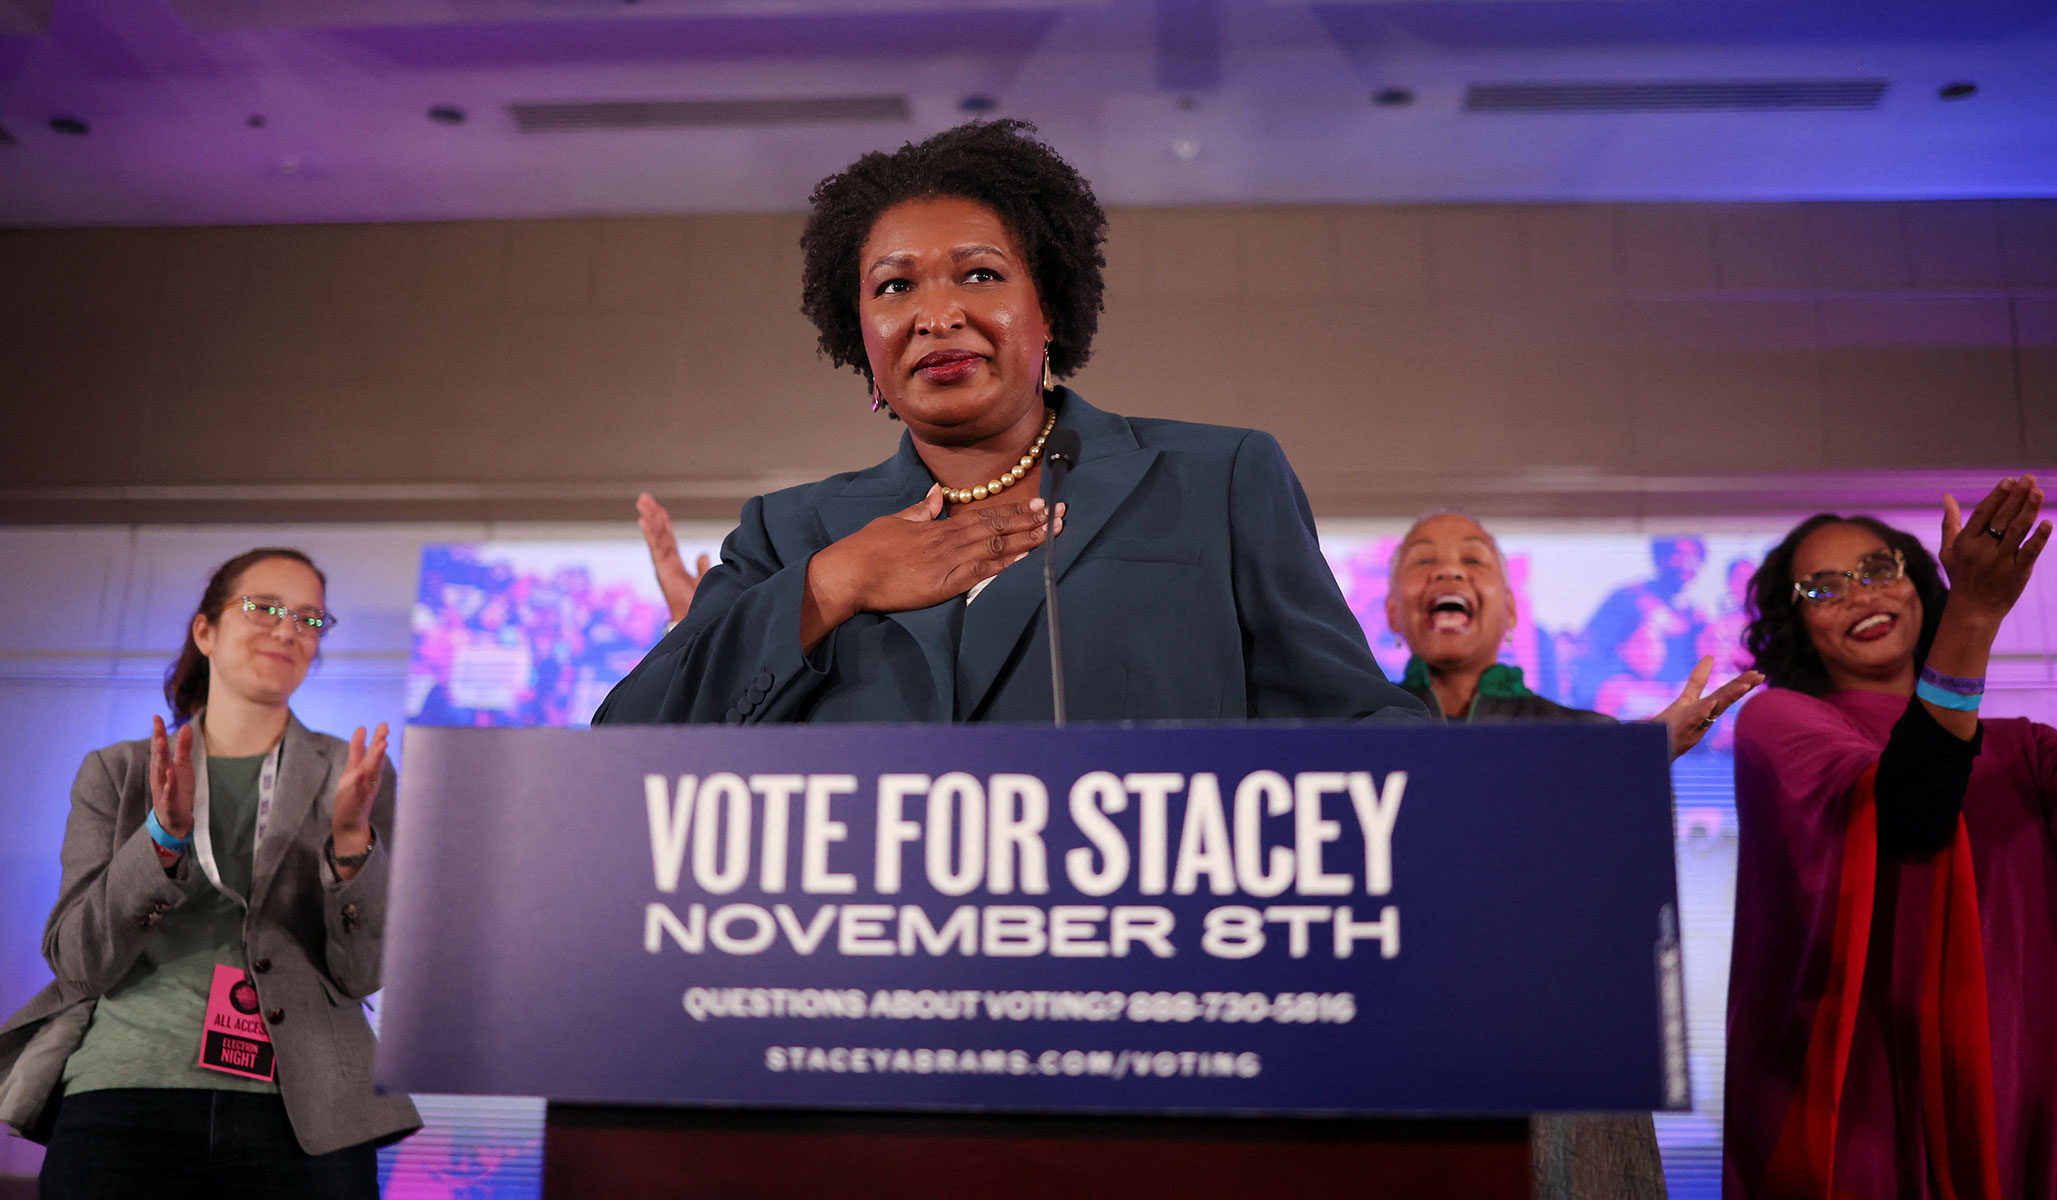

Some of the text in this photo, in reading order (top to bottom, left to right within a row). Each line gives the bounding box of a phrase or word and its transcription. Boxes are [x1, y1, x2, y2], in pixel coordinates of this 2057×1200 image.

[643, 769, 1407, 898] VOTE FOR STACEY
[643, 902, 1400, 959] NOVEMBER 8TH
[682, 986, 868, 1021] QUESTIONS
[869, 988, 980, 1020] ABOUT
[981, 989, 1125, 1022] VOTING?
[214, 1013, 268, 1036] ALL ACCES
[221, 1047, 258, 1069] NIGHT
[222, 1037, 259, 1054] ELECTION
[765, 1045, 1261, 1078] STACEYABRAMS.COM/VOTING
